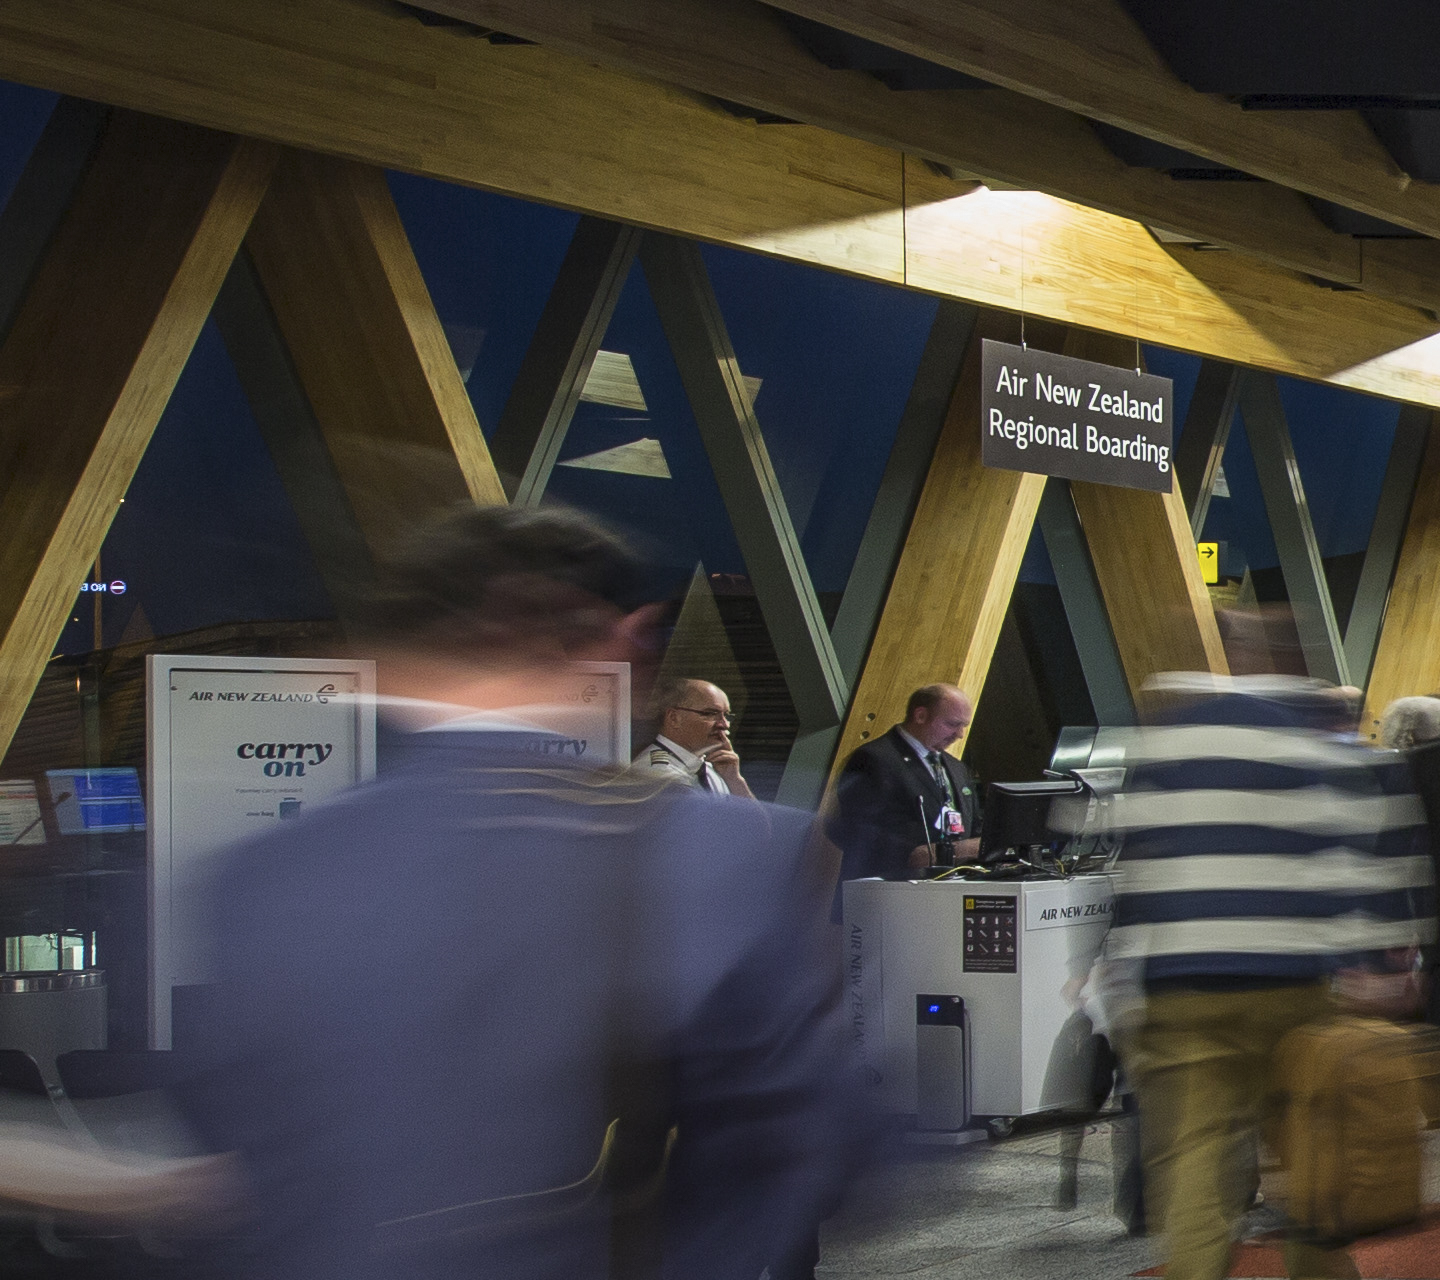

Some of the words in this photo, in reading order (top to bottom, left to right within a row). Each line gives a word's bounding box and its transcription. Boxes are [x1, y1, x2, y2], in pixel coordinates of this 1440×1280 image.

[995, 365, 1029, 398] Air
[1035, 372, 1082, 408] New
[1087, 383, 1164, 424] Zealand
[989, 407, 1079, 451] Regional
[1085, 425, 1170, 473] Boarding
[188, 691, 214, 702] AIR
[217, 691, 249, 702] NEW
[250, 692, 313, 703] ZEALAND
[236, 742, 333, 766] carry
[263, 760, 306, 778] on
[1039, 908, 1058, 921] AIR
[1060, 906, 1083, 919] NEW
[1083, 902, 1116, 917] ZEALA
